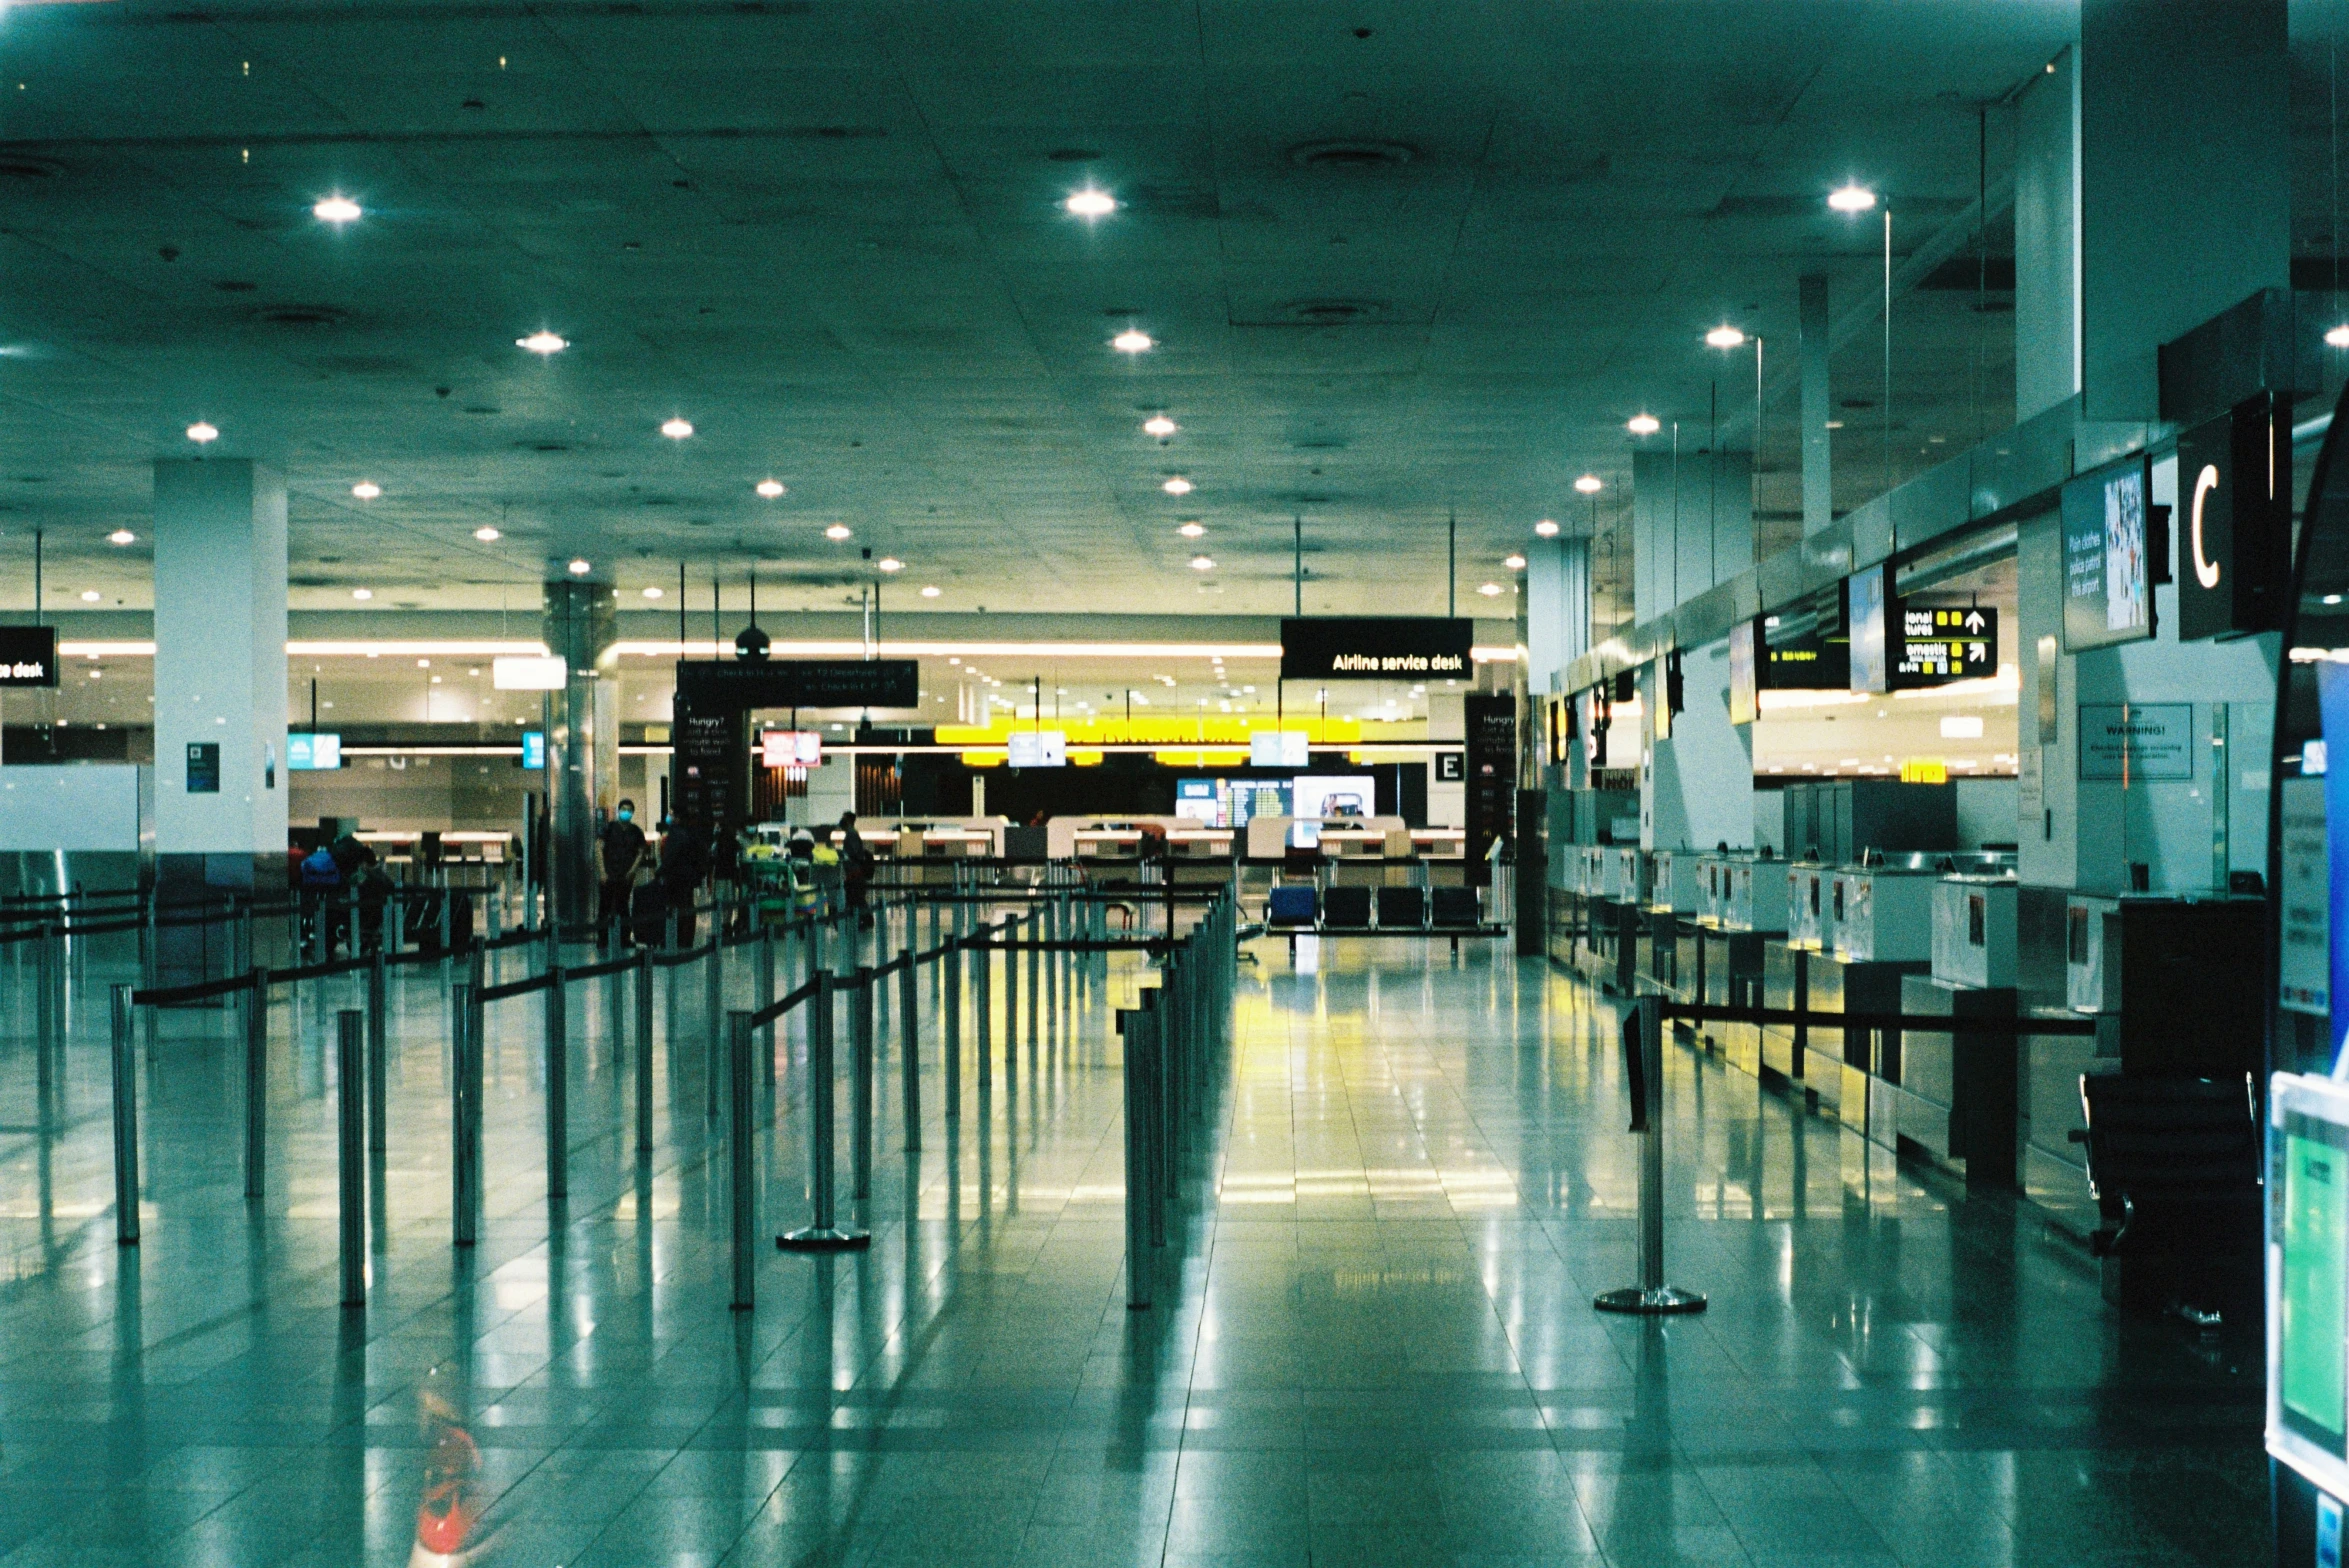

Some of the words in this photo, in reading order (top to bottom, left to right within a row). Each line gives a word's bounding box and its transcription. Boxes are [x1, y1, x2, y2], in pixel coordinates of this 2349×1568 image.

[2192, 464, 2220, 589] C
[2082, 577, 2100, 599] airport
[1905, 610, 1933, 624] ional
[1905, 624, 1933, 636] tures
[1906, 641, 1948, 656] omestic
[13, 661, 44, 678] desk
[1333, 654, 1379, 670] Airline
[1382, 654, 1429, 670] service
[1431, 654, 1462, 670] desk
[689, 717, 725, 728] Hungry?
[2106, 726, 2166, 736] WARNING!
[1443, 755, 1459, 778] E
